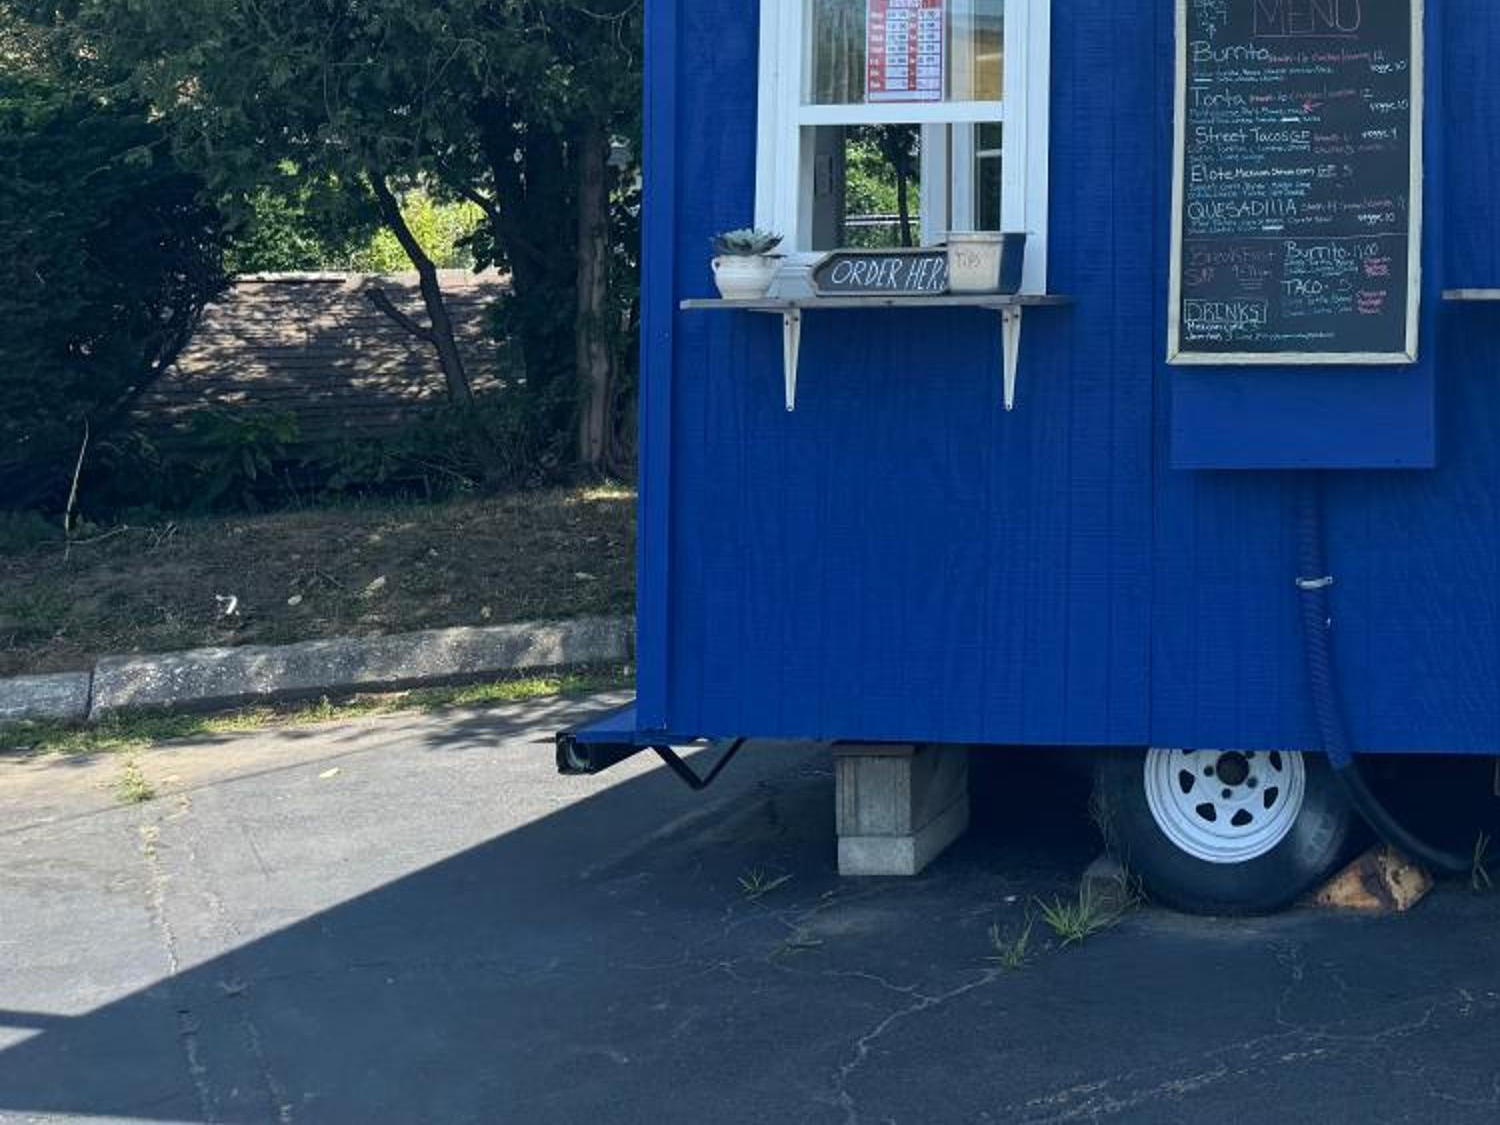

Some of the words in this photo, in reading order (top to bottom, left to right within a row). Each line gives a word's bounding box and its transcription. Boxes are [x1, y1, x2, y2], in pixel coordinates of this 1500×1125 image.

[1189, 85, 1248, 107] Torta
[1195, 125, 1249, 145] Street
[1191, 160, 1235, 183] Elote
[831, 258, 902, 288] ORDER
[1186, 301, 1260, 322] DRINKS
